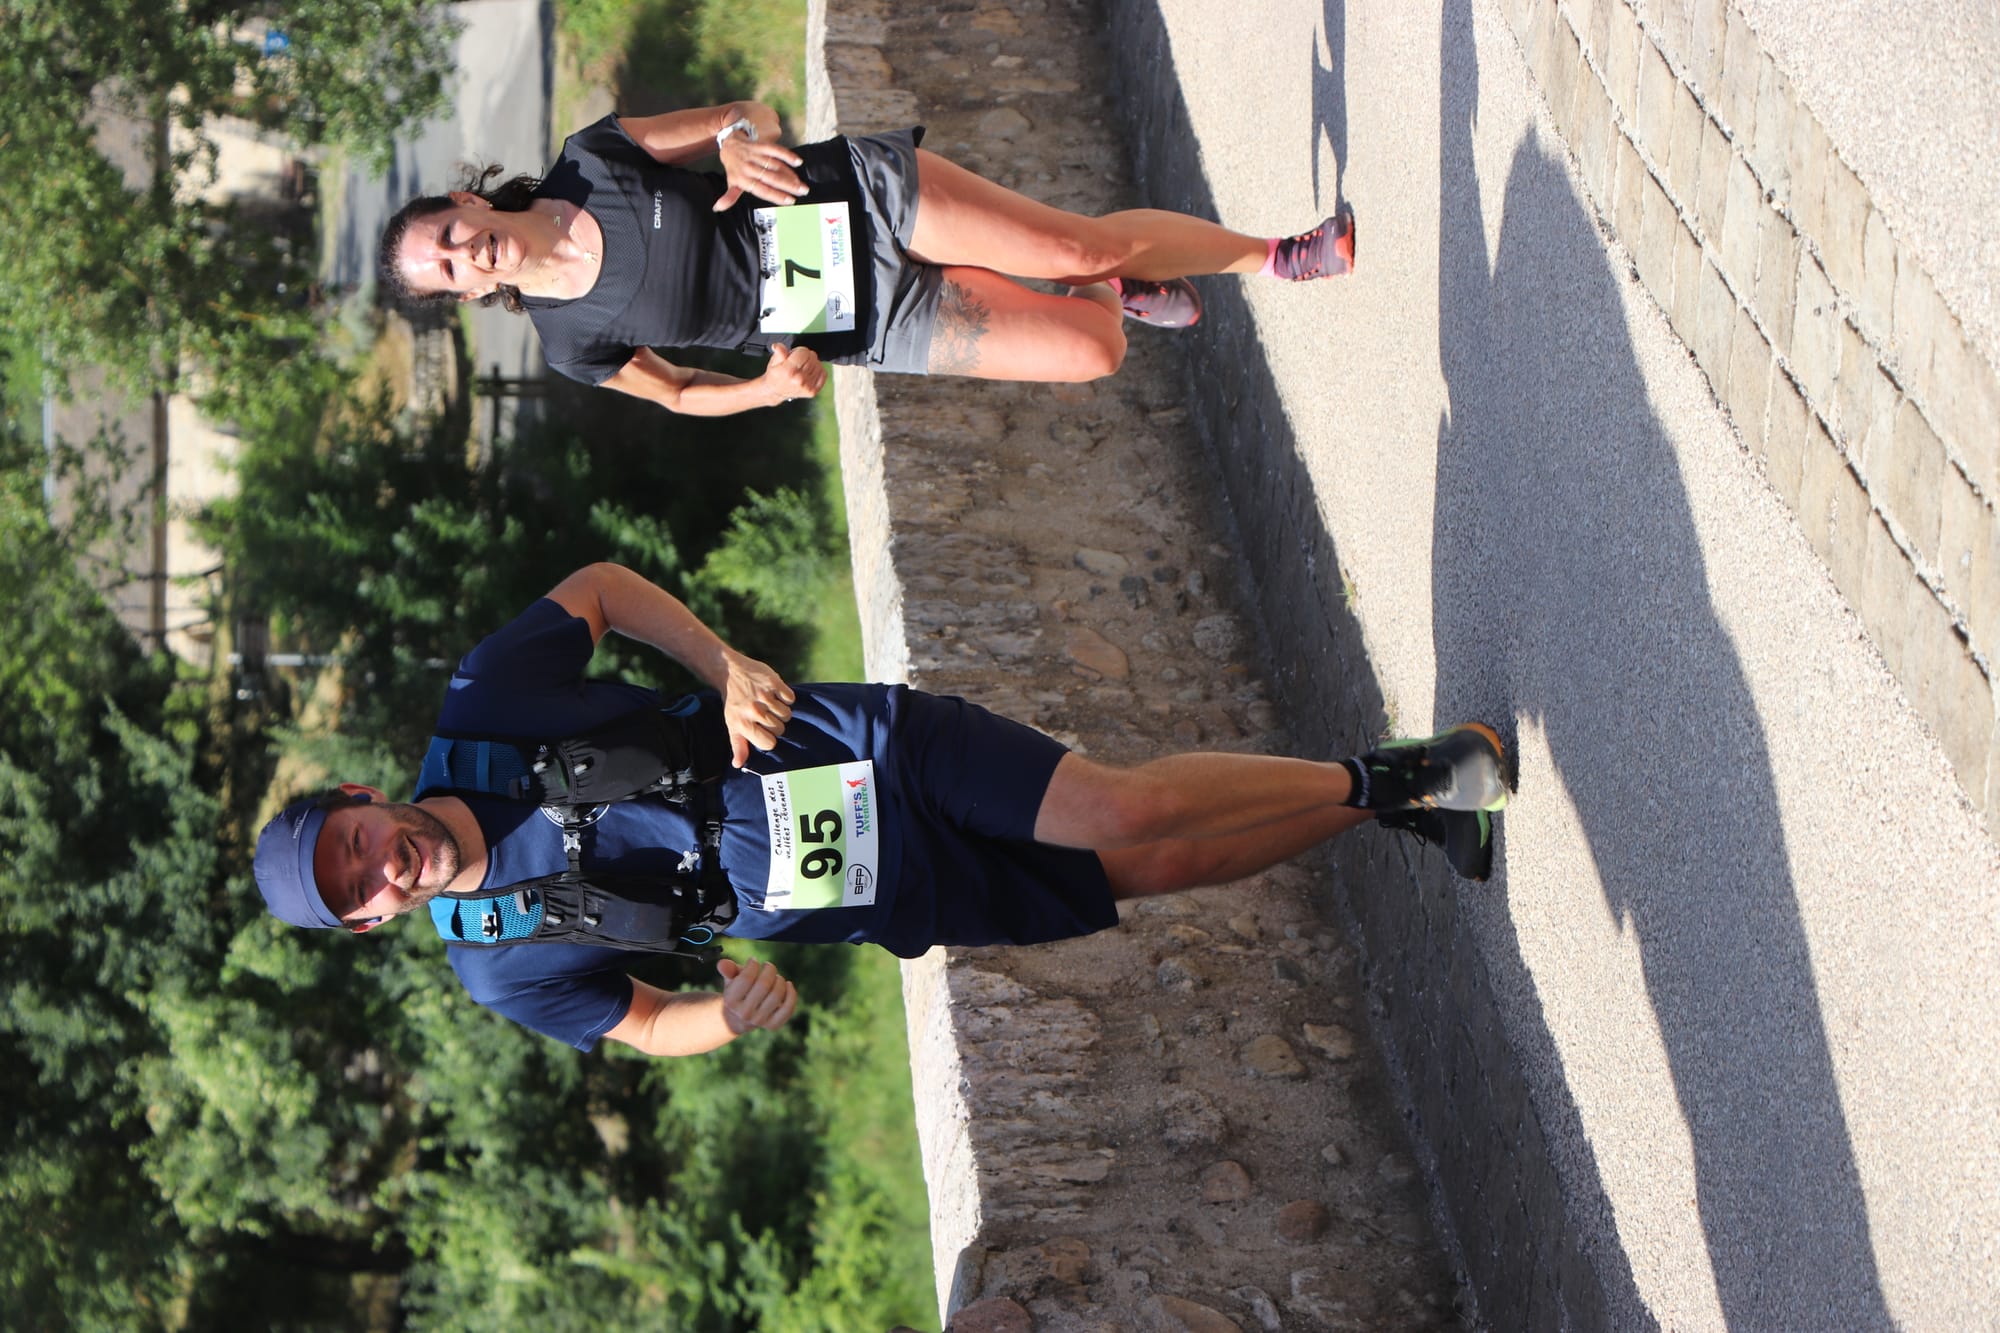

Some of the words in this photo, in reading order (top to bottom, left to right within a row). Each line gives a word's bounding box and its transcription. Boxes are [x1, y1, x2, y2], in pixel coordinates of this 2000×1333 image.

[830, 228, 840, 267] TUFF'S
[785, 259, 821, 287] 7
[768, 787, 776, 802] des
[777, 780, 788, 821] cévenoles
[860, 786, 870, 832] Aventure
[774, 808, 782, 855] Challenge
[853, 792, 864, 838] TUFF'S
[782, 827, 792, 859] vallées
[799, 809, 843, 879] 95
[854, 868, 864, 895] BFP
